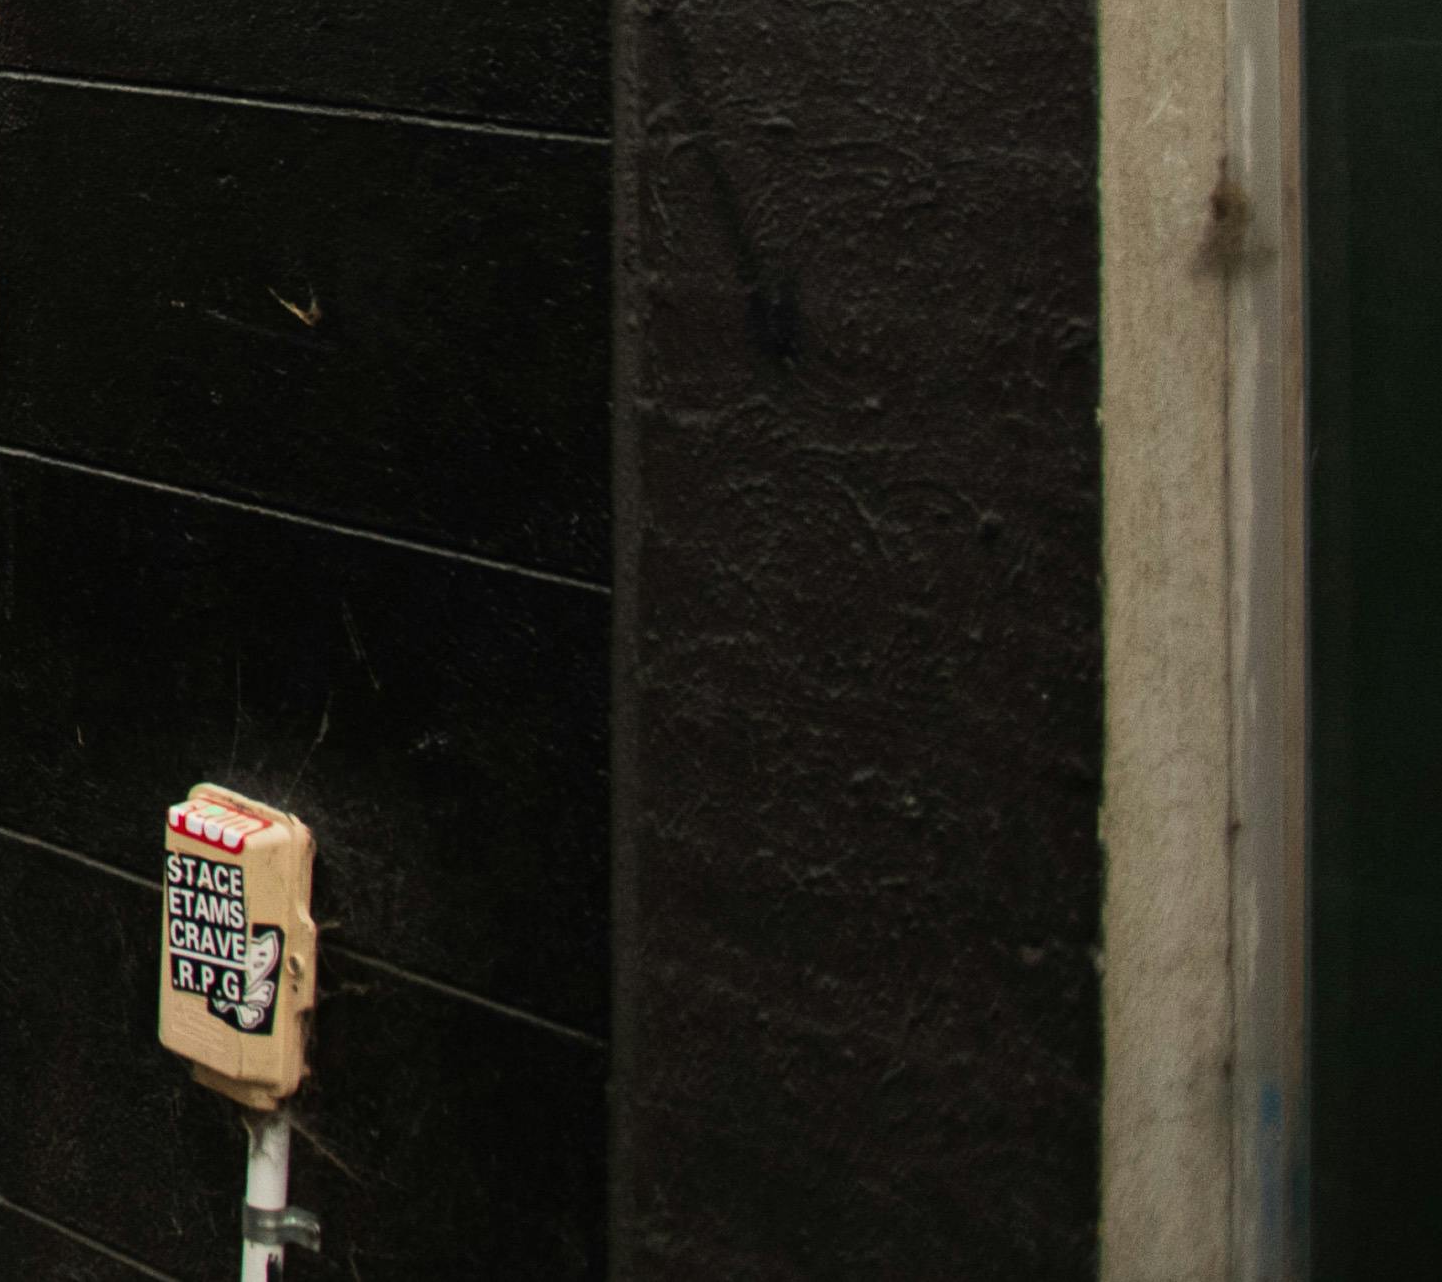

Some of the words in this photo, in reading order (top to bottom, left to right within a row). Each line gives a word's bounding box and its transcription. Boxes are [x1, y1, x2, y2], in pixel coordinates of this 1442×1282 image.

[167, 853, 243, 897] STACE
[168, 886, 244, 930] ETAMS
[170, 918, 246, 962] CRAVE
